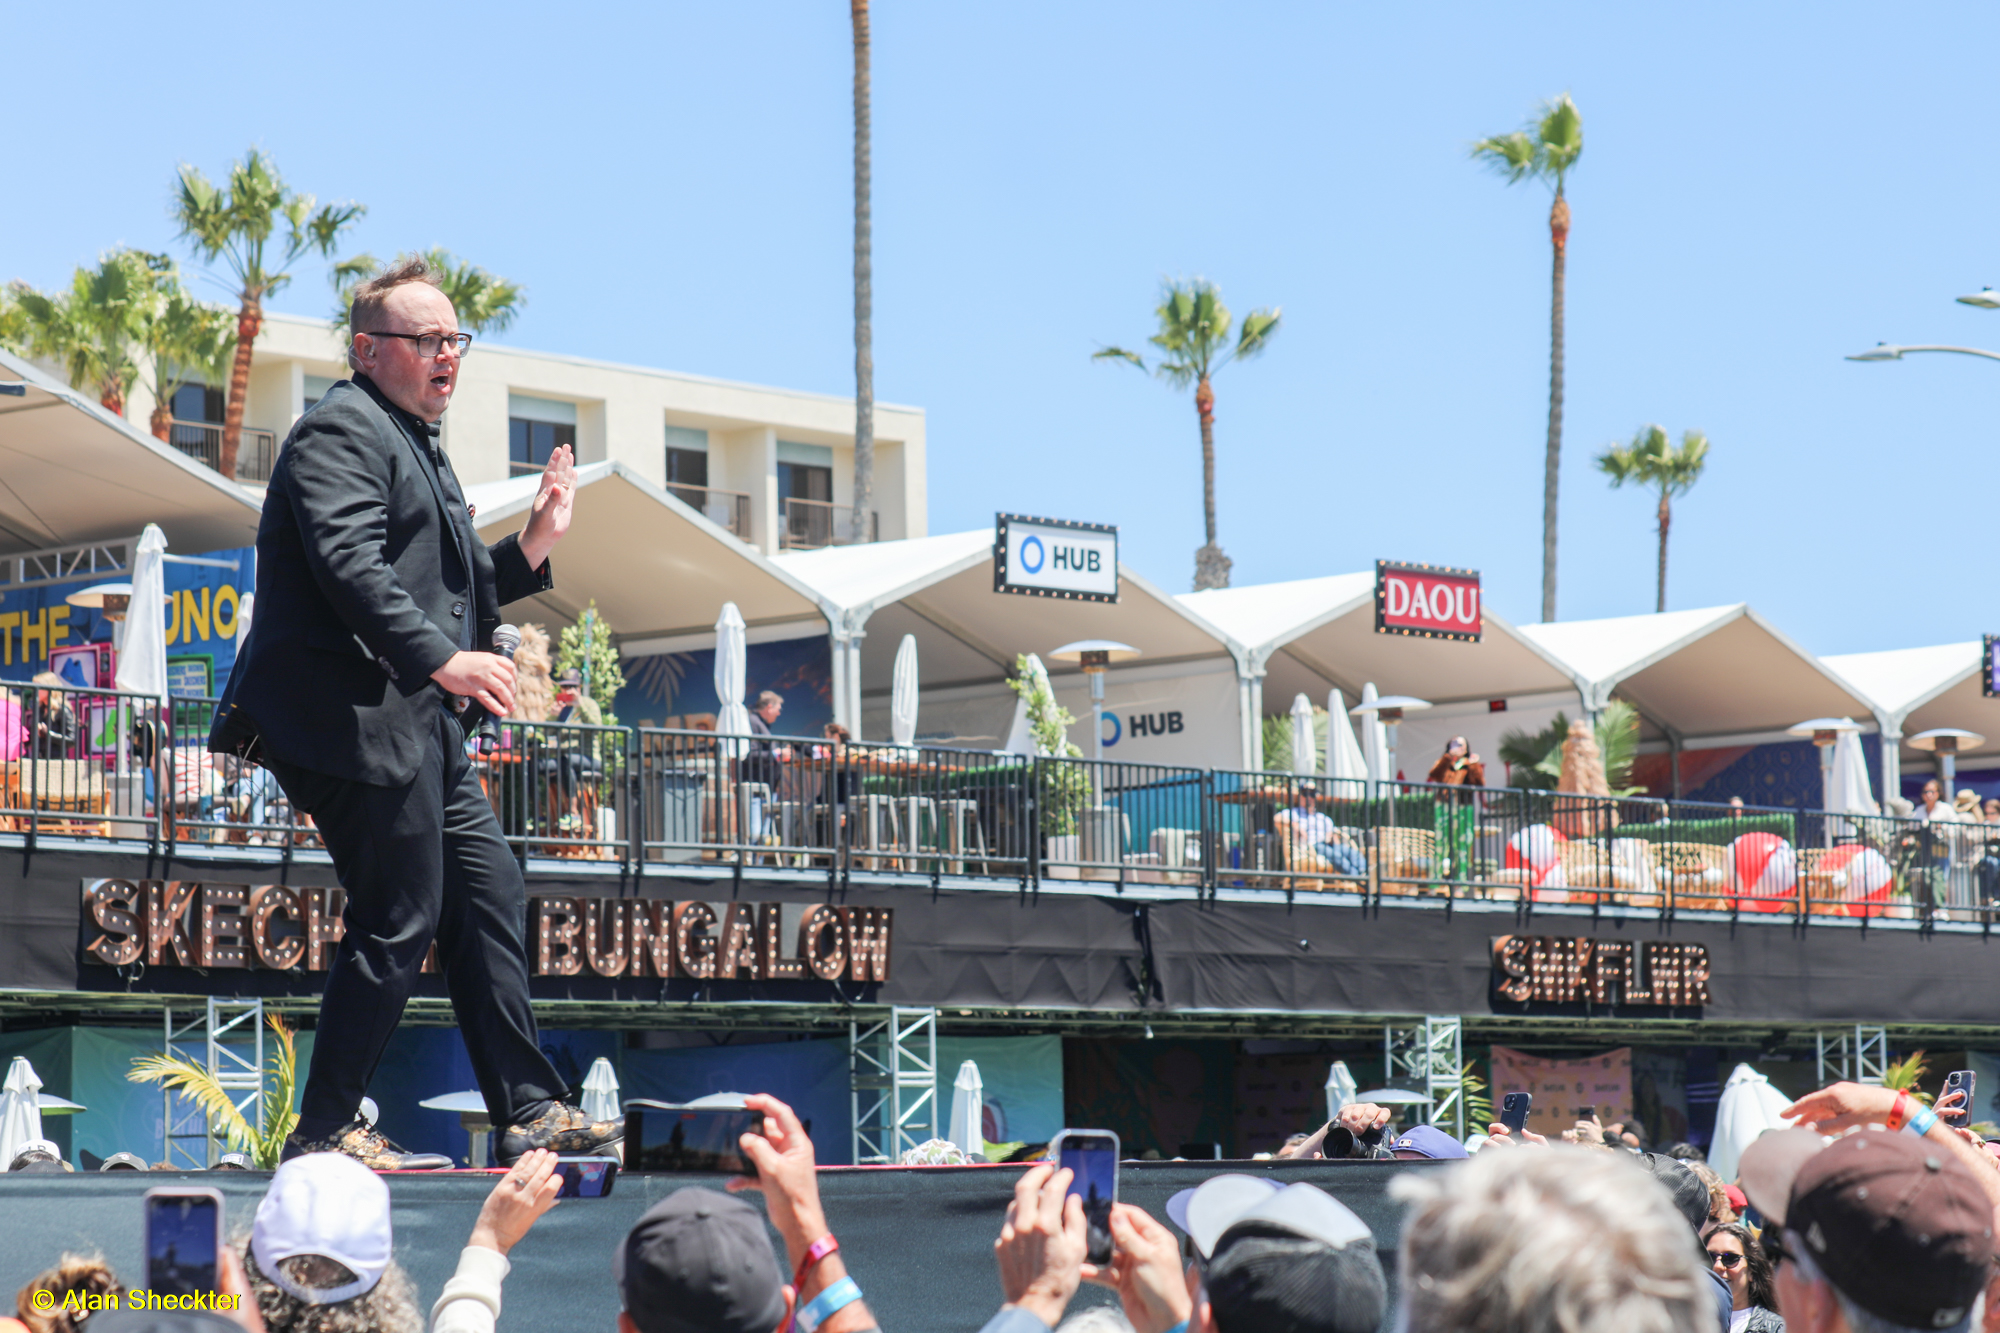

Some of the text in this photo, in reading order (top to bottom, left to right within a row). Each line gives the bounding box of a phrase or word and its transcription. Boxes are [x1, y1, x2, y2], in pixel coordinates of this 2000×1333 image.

[1053, 545, 1101, 573] HUB
[1386, 577, 1478, 625] DAOU
[0, 604, 71, 666] THE
[1129, 711, 1184, 738] HUB
[531, 895, 894, 982] BUNGALOW
